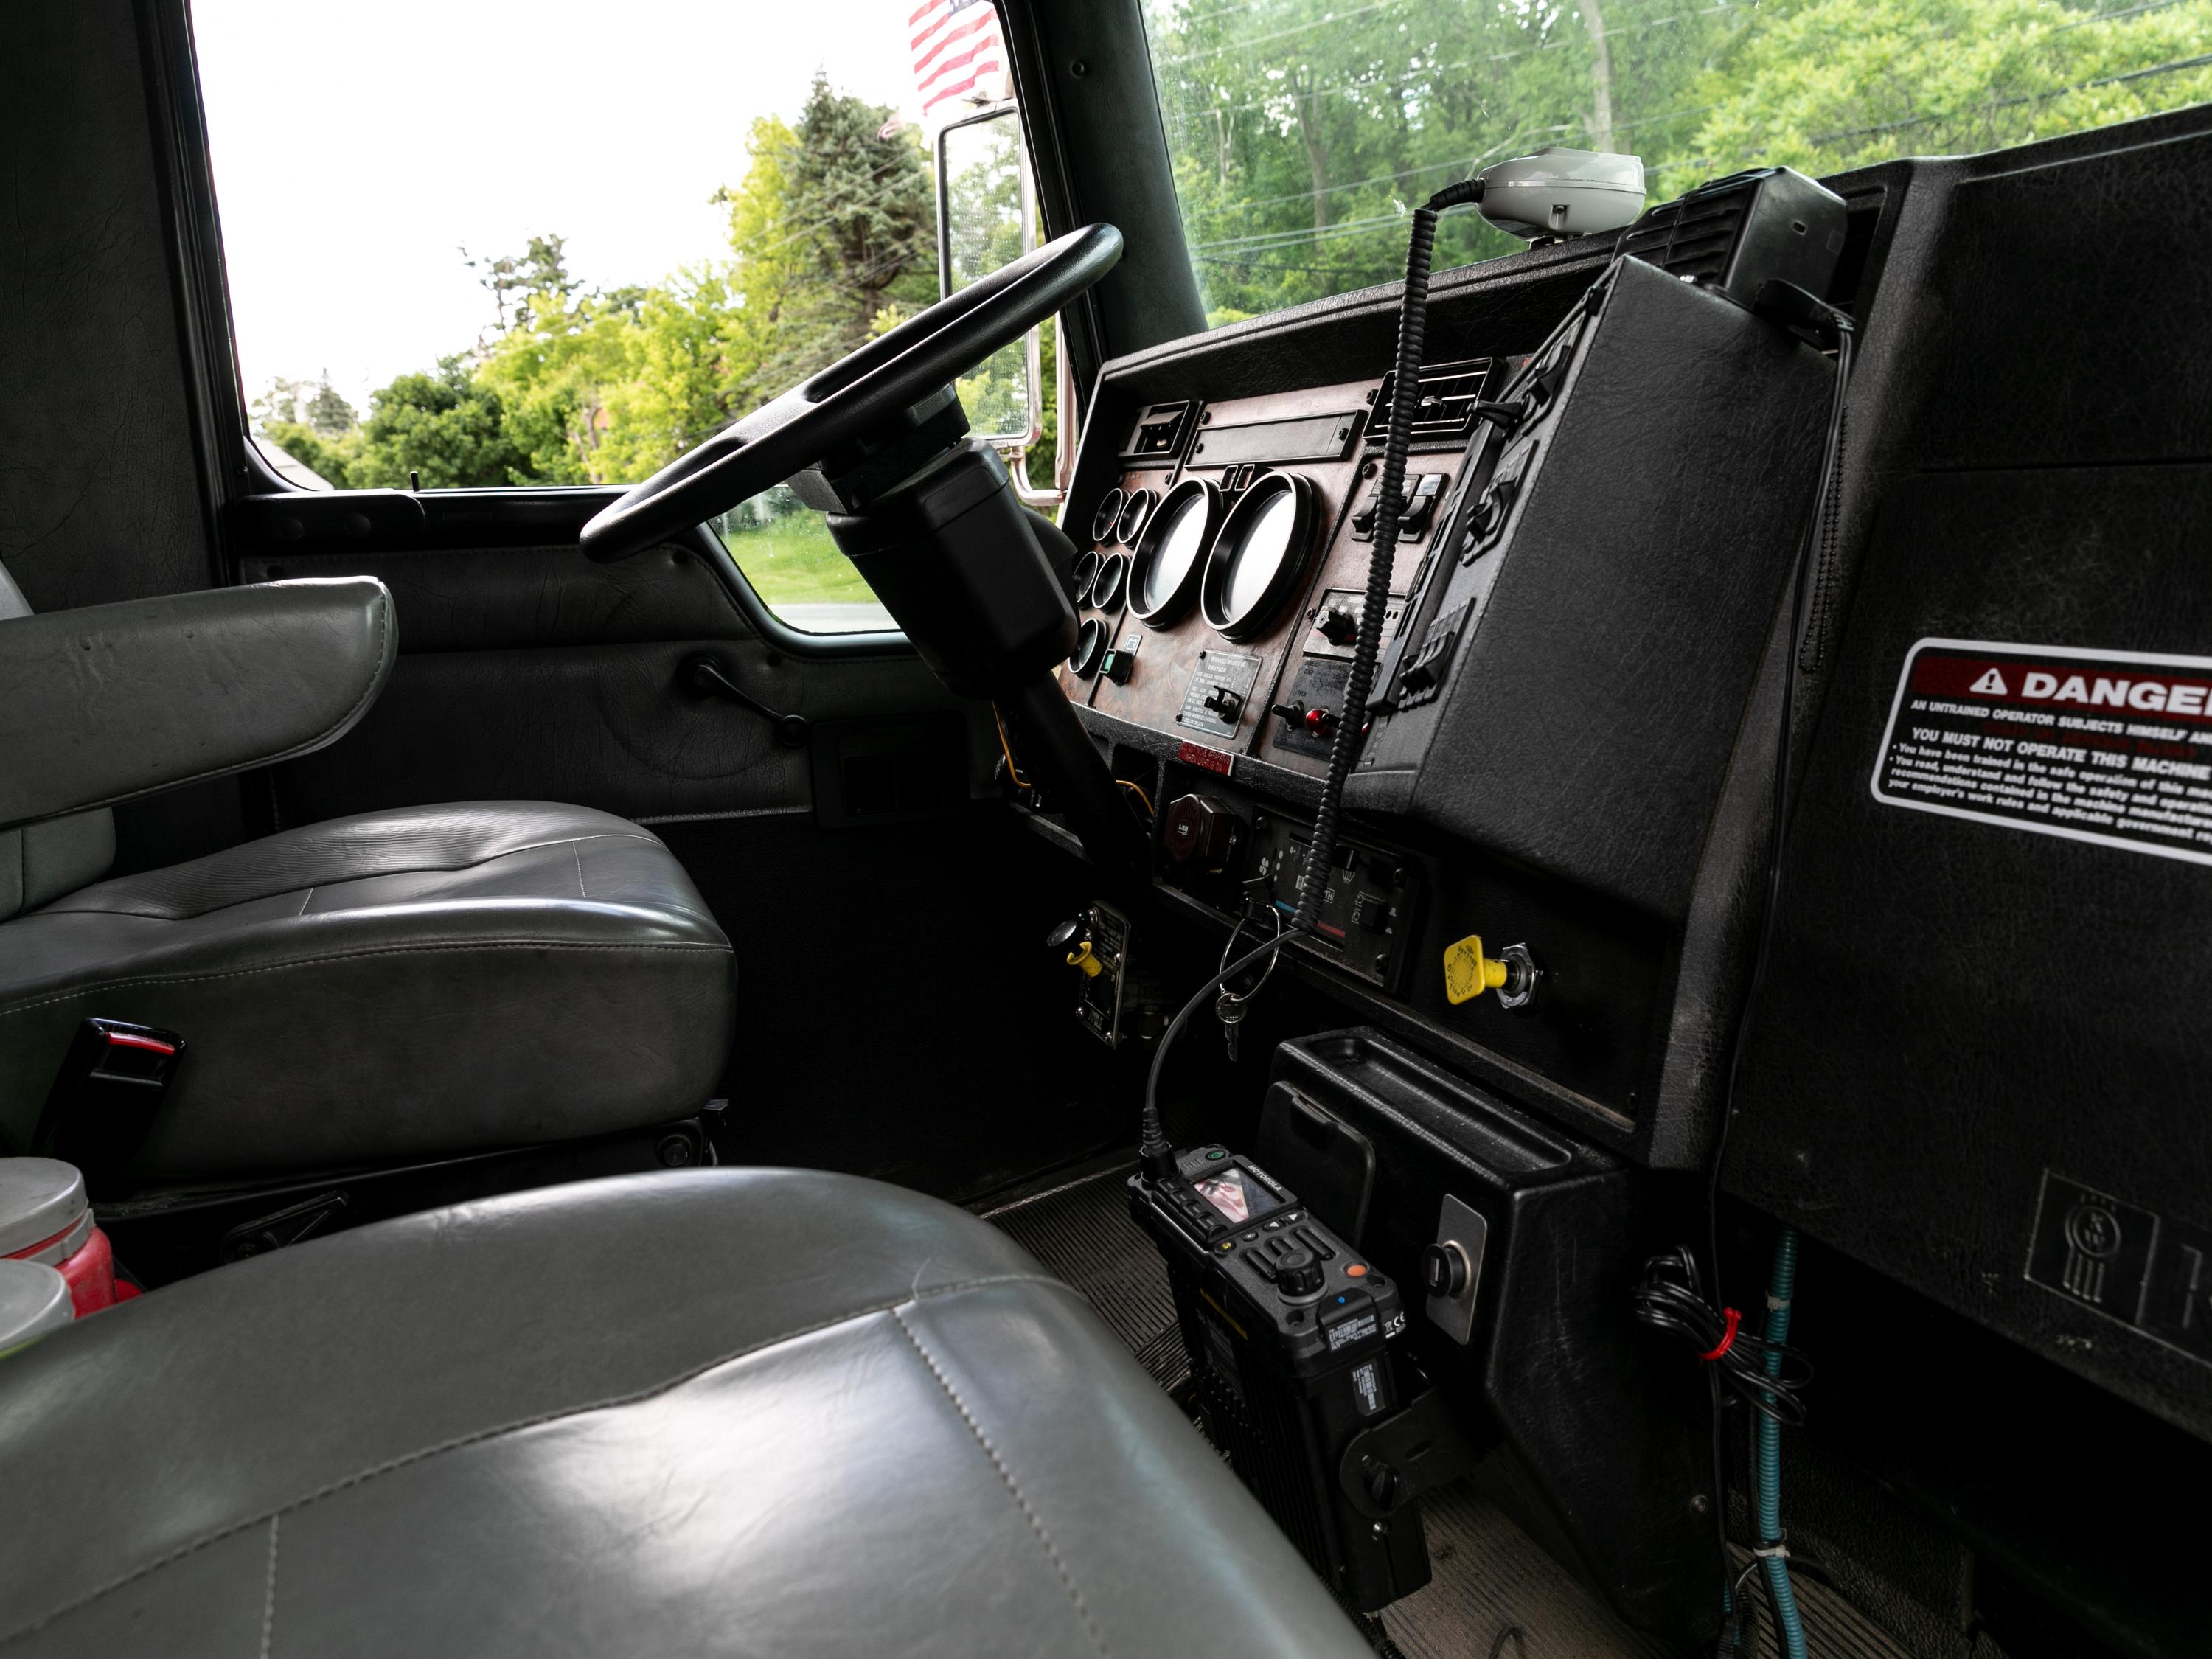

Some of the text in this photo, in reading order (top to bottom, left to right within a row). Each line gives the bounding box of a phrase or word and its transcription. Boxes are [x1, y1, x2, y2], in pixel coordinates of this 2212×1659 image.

[1911, 700, 1927, 710] AN
[1929, 702, 1989, 717] UNTRAINED
[1992, 709, 2055, 726] OPERATOR
[2058, 717, 2124, 734] SUBJECTS
[2126, 724, 2188, 741] HIMSELF
[1899, 743, 1916, 754] You
[1919, 746, 1942, 757] have
[1944, 750, 1970, 762] been
[1973, 754, 2011, 768] trained
[2013, 759, 2025, 770] in
[2028, 762, 2047, 773] the
[2050, 767, 2076, 778] safe
[2079, 771, 2138, 787] operation
[2140, 779, 2156, 790] of
[2158, 782, 2184, 795] this
[1913, 727, 2212, 780] YOU MUST NOT OPERATE THIS MACHINE
[1891, 768, 1978, 789] recommendations
[1980, 783, 2035, 798] contained
[2037, 790, 2048, 801] in
[2051, 792, 2071, 804] the
[2073, 798, 2126, 813] machine
[1896, 755, 1913, 766] You
[1915, 760, 1939, 772] read,
[1943, 765, 2002, 780] understand
[2004, 774, 2026, 784] and
[2028, 776, 2063, 790] follow
[2066, 782, 2086, 793] the
[2089, 787, 2129, 802] safety
[2131, 793, 2157, 805] and
[1888, 779, 1910, 788] your
[1968, 793, 1994, 804] work
[1996, 797, 2024, 808] rules
[2027, 802, 2050, 813] and
[2051, 807, 2113, 824] applicable
[2116, 818, 2194, 839] government
[1247, 1165, 1282, 1191] MOTOROLA
